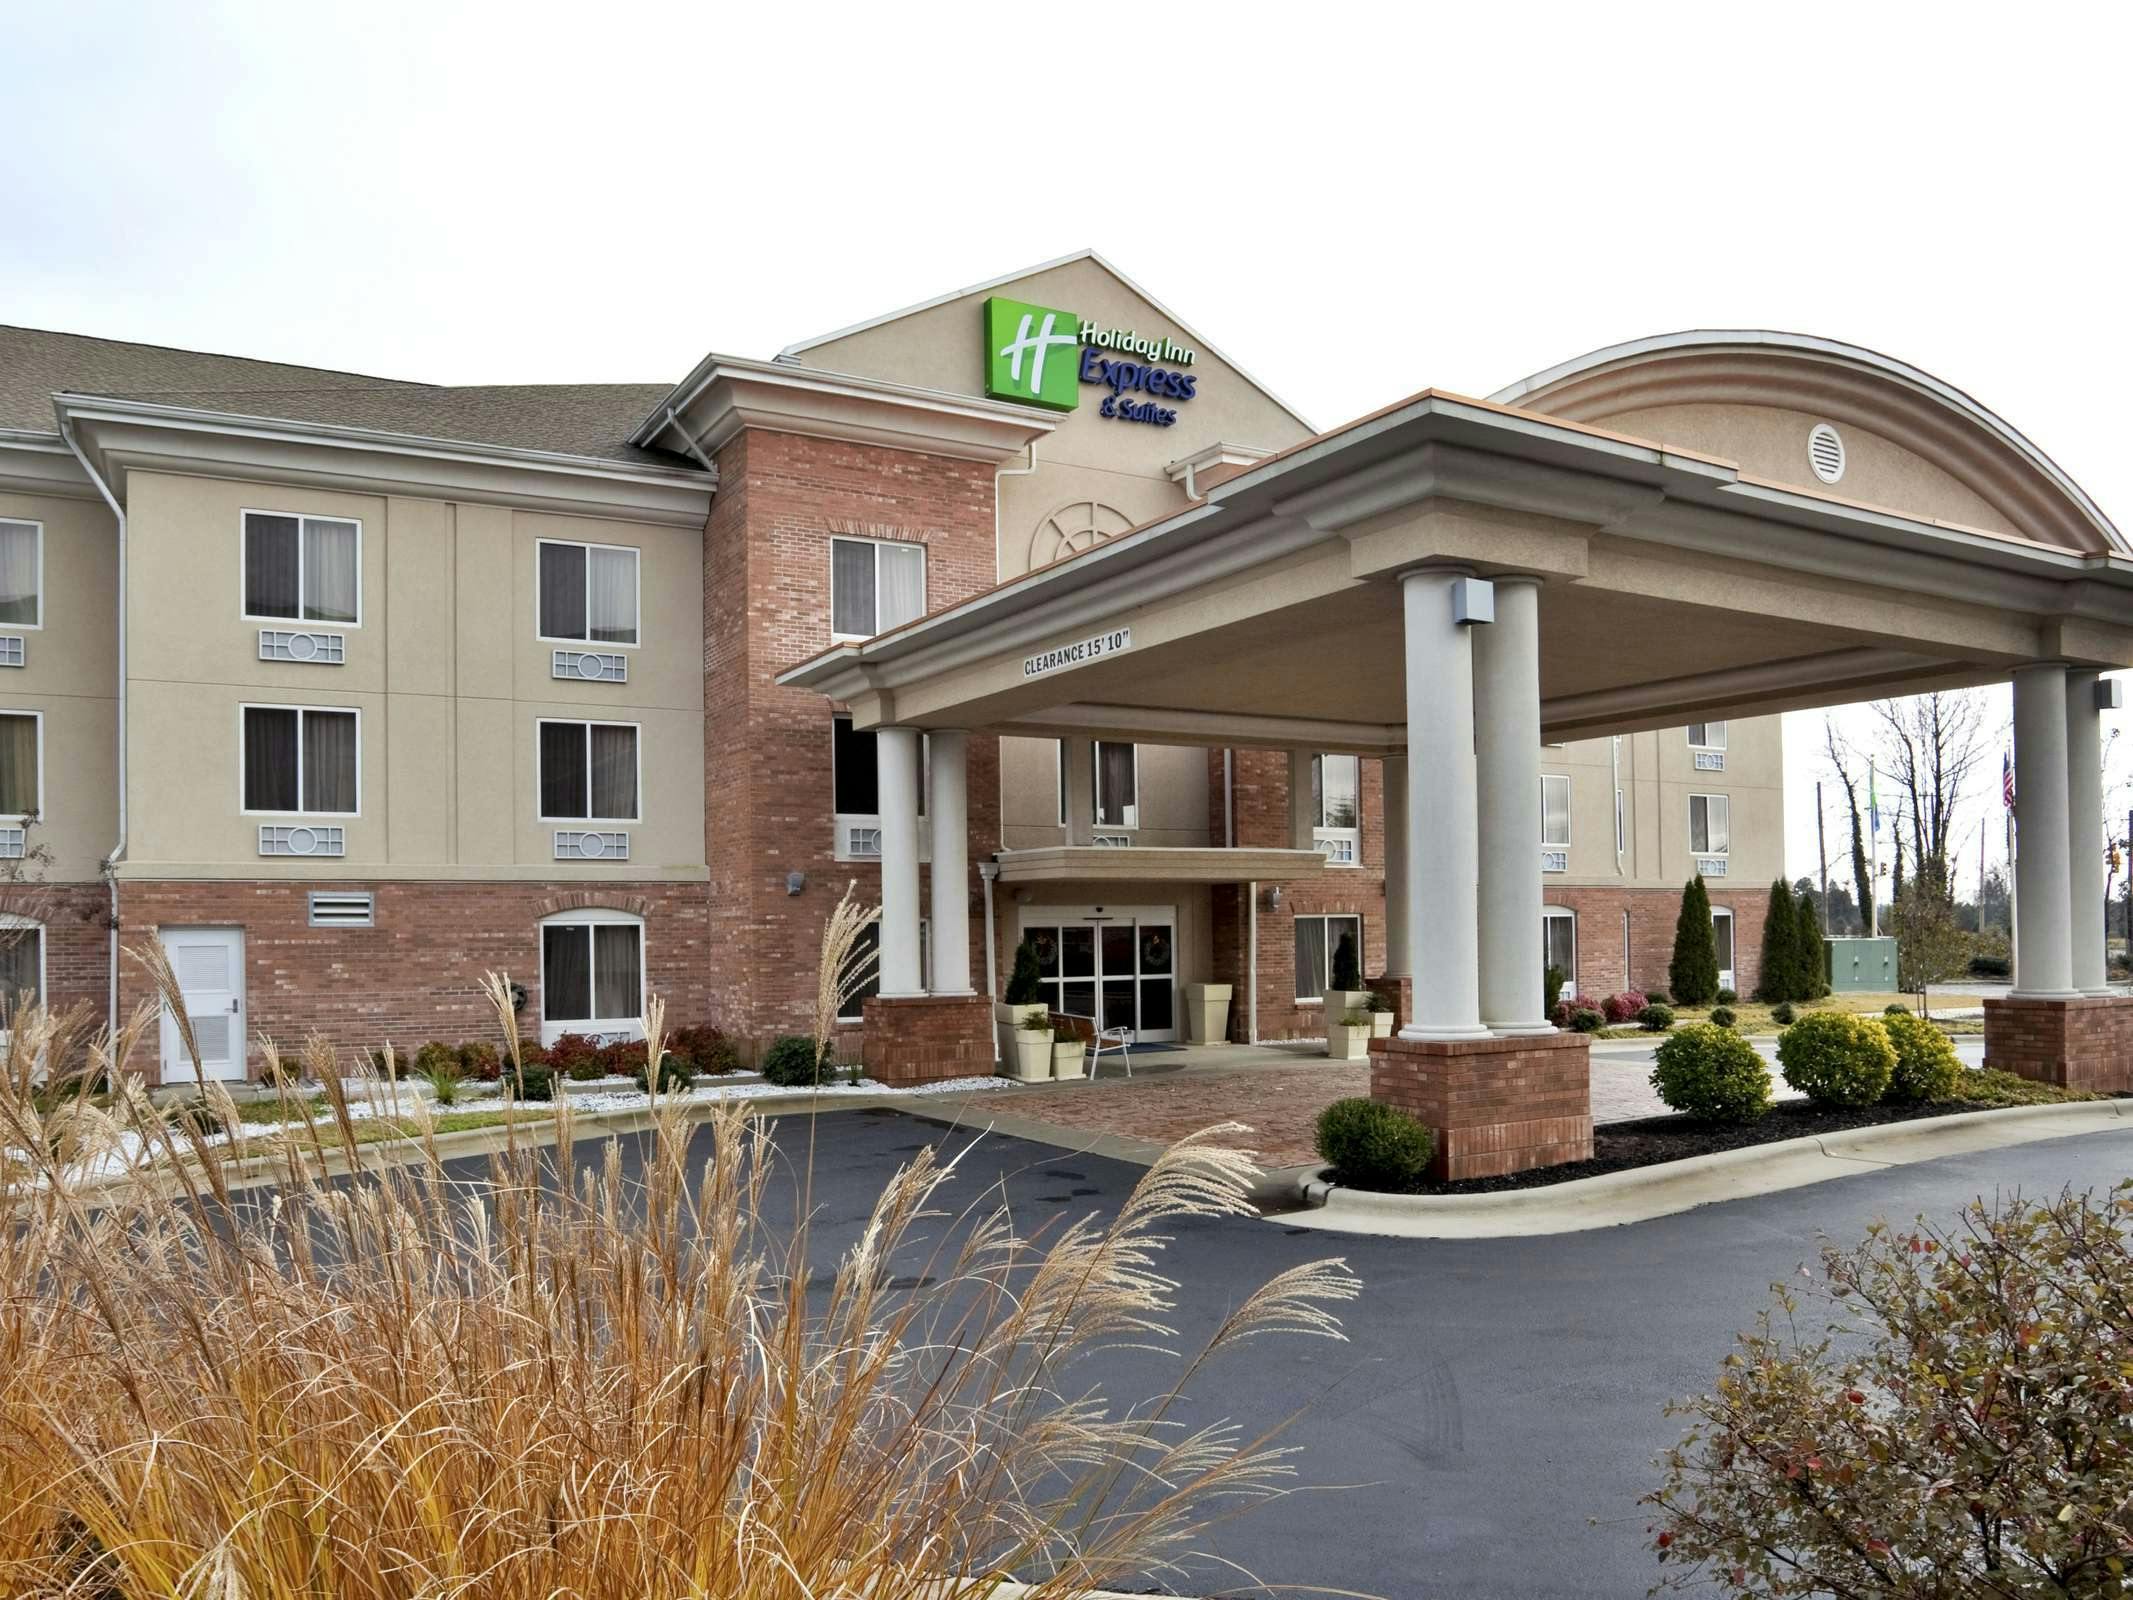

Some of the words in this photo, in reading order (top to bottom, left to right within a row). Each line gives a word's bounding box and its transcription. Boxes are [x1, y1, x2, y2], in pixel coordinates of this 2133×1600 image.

[1080, 319, 1160, 362] Holiday
[1164, 337, 1196, 366] Inn
[1079, 347, 1197, 401] Express
[1100, 395, 1118, 418] &
[1118, 398, 1177, 427] Suites
[1024, 644, 1084, 675] CLEARANCE
[1087, 638, 1105, 657] 15'
